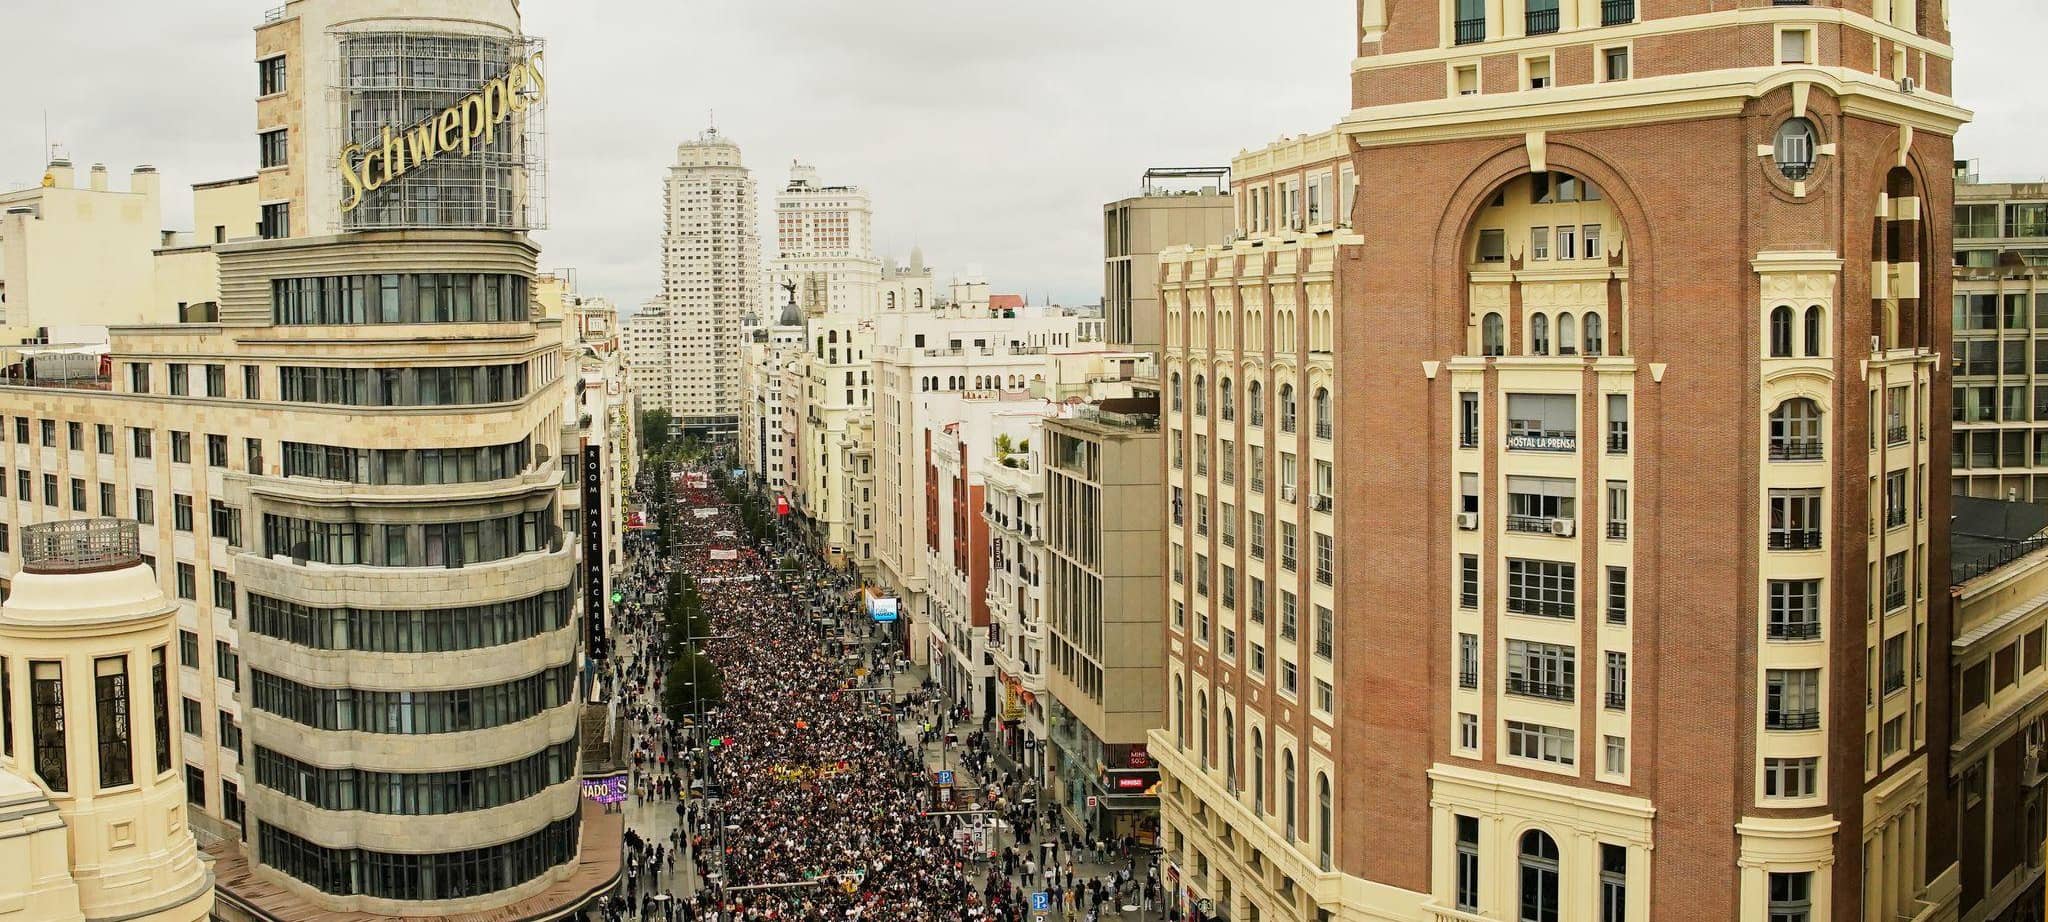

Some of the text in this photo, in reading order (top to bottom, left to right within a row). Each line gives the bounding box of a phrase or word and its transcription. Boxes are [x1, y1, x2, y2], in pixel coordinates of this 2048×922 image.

[339, 50, 545, 213] Schweppes
[1509, 436, 1576, 449] HOSTAL LA PRENSA
[621, 455, 629, 533] EMPERADOR
[589, 450, 601, 654] ROOM MATE MACARENA
[1036, 895, 1046, 909] P
